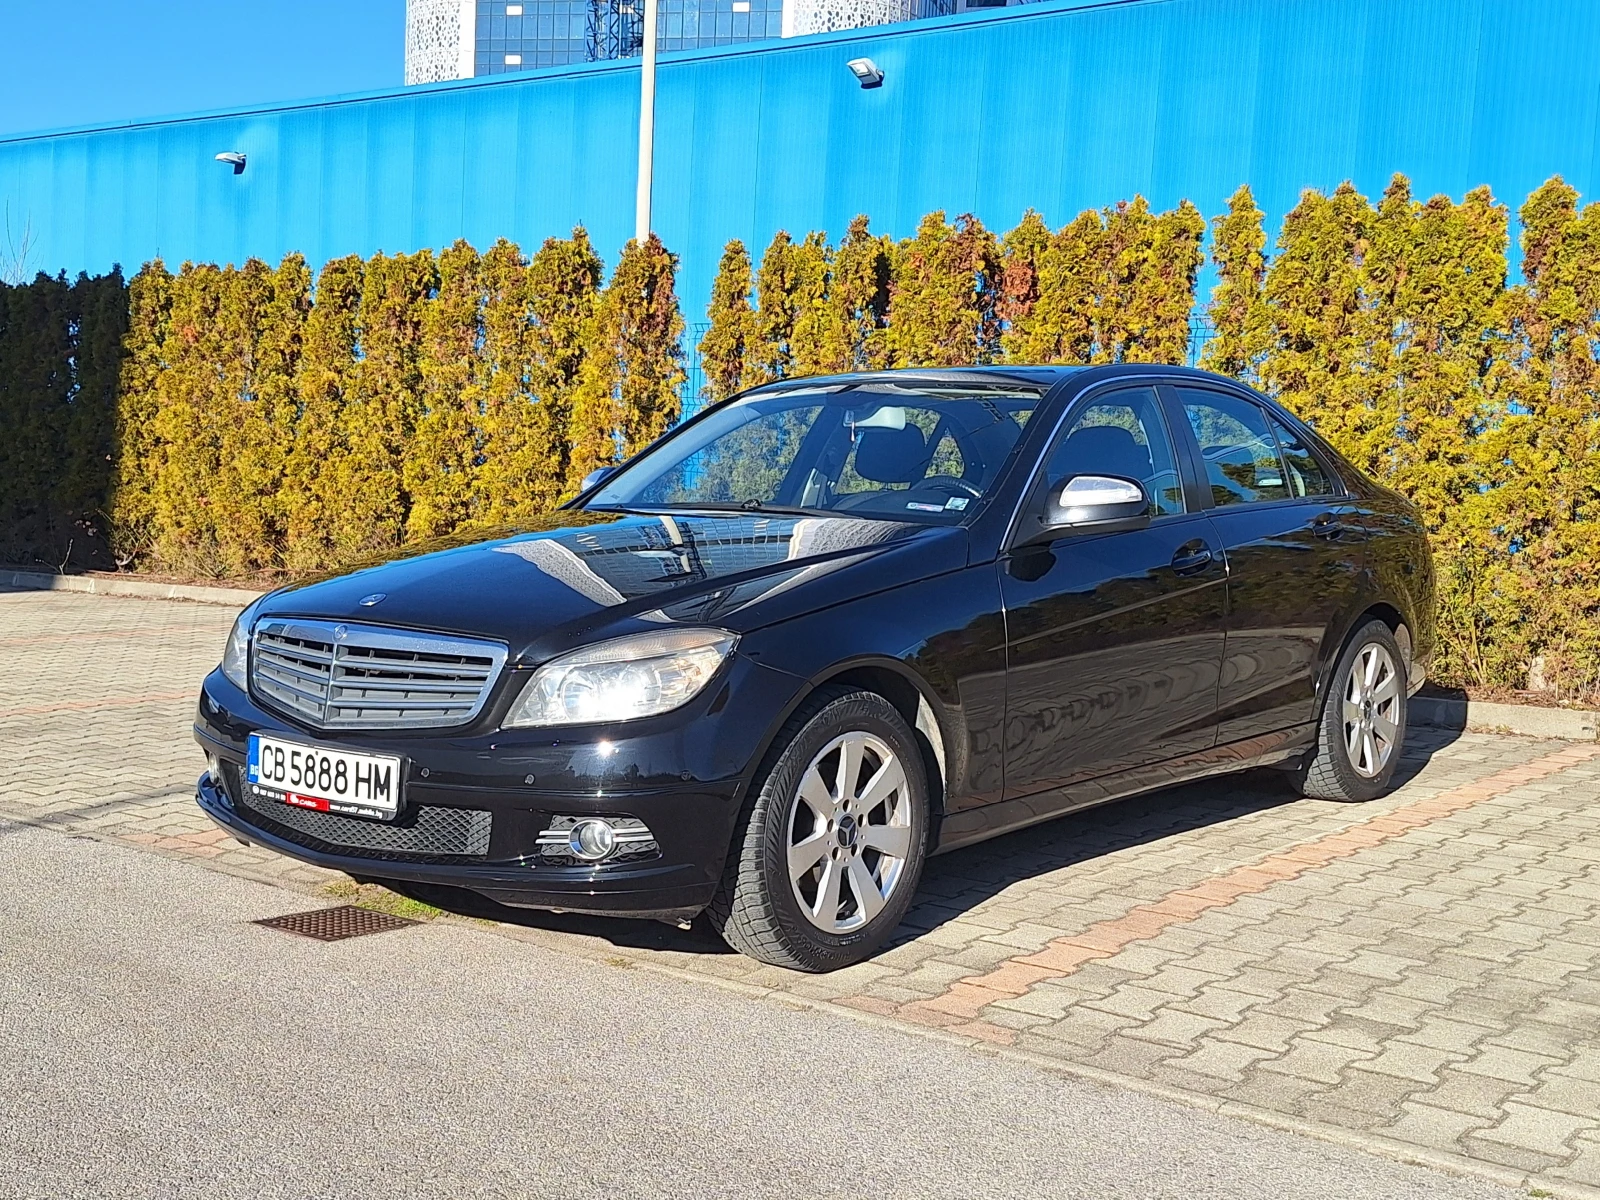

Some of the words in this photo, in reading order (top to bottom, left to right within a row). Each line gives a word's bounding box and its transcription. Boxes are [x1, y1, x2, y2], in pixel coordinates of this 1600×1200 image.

[250, 764, 259, 776] BG
[262, 744, 285, 782] CB
[291, 750, 348, 795] 5888
[355, 761, 391, 802] HM
